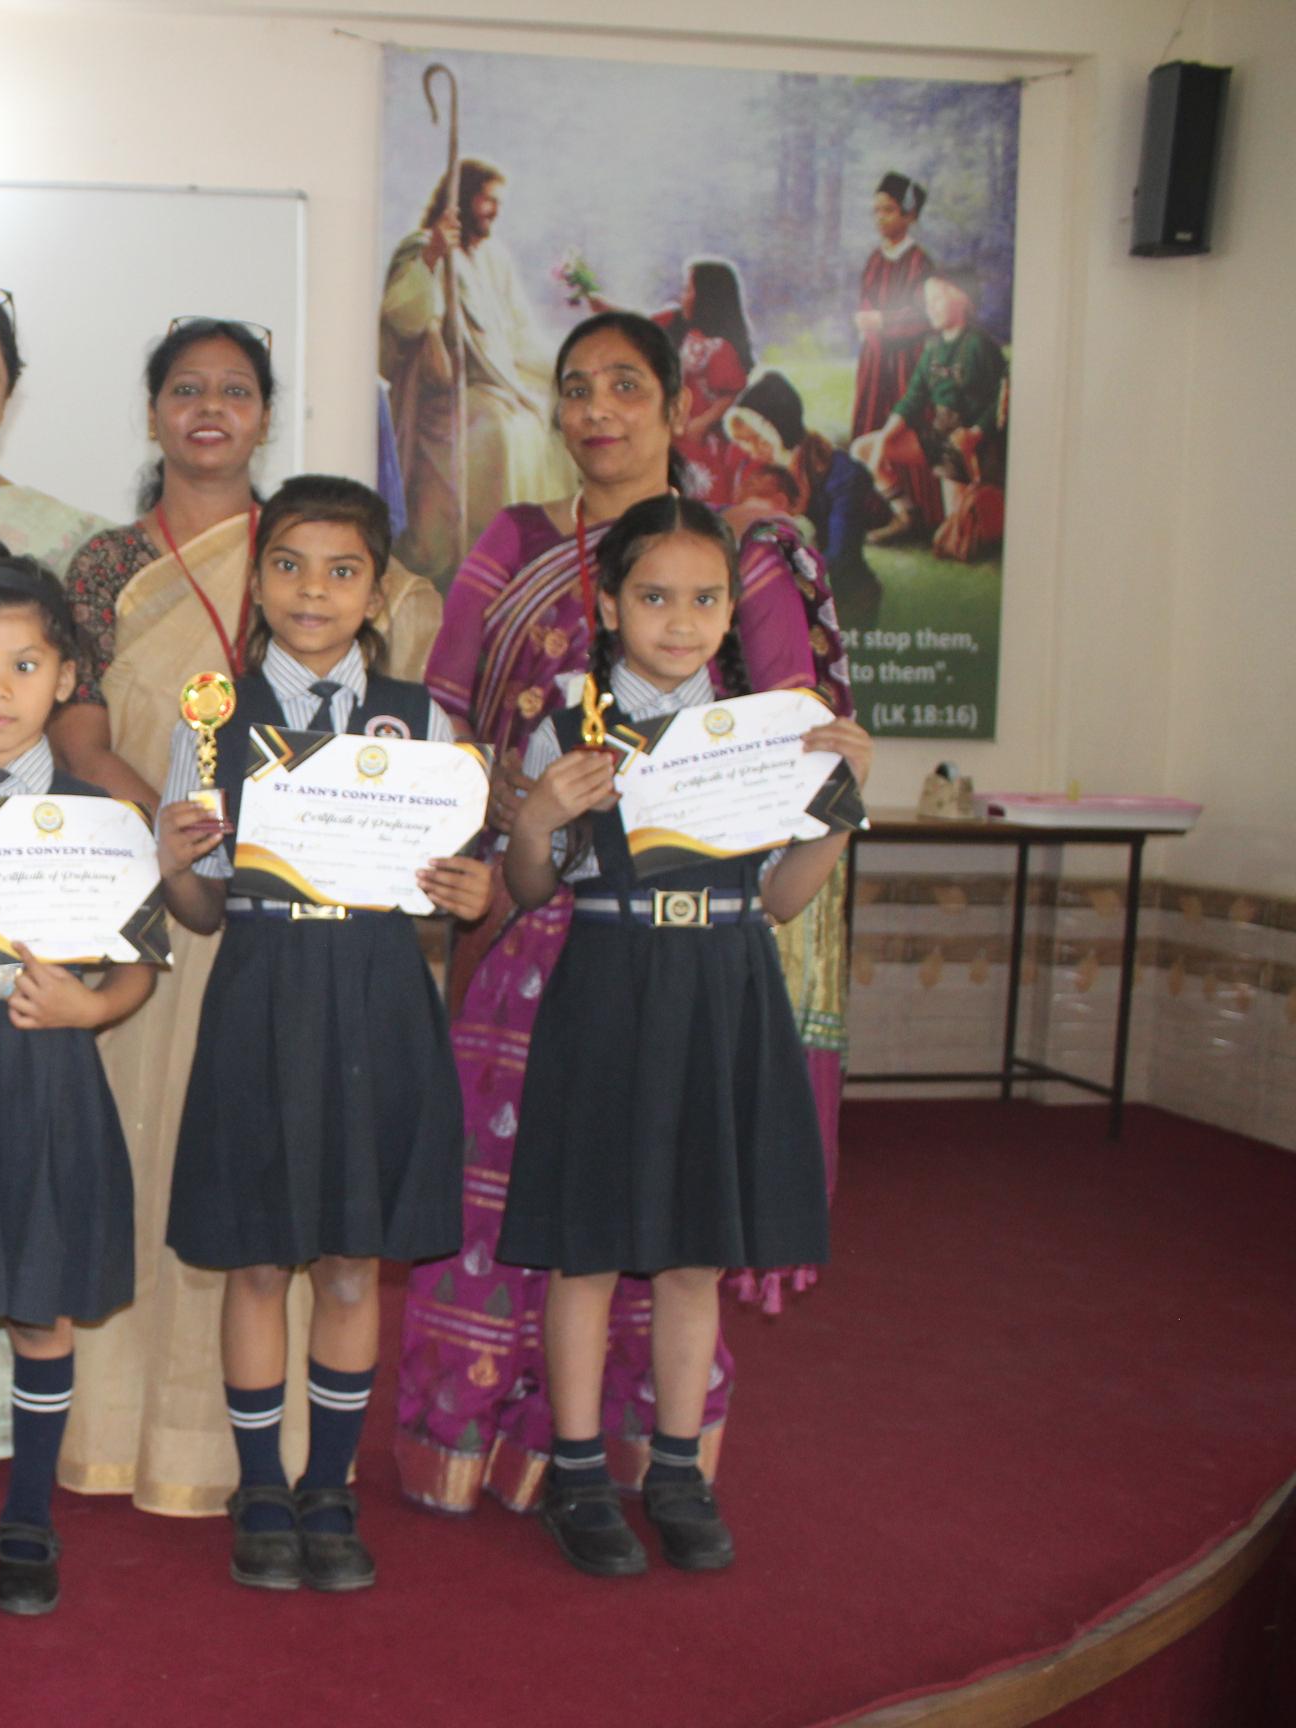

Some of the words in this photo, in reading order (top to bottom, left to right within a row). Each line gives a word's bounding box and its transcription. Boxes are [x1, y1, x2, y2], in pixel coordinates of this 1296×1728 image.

[839, 628, 859, 648] ot
[864, 628, 912, 652] stop
[915, 627, 979, 652] them,
[851, 662, 875, 682] to
[872, 703, 907, 729] (LK
[912, 703, 978, 730] 18:16)
[640, 766, 659, 776] ST.
[662, 755, 700, 770] ANN'S
[702, 740, 762, 760] CONVENT
[765, 733, 802, 747] SCHO
[674, 769, 723, 792] Certificate
[739, 758, 797, 778] Proficiency
[274, 782, 294, 793] ST.
[297, 784, 338, 798] ANN'S
[341, 788, 405, 804] CONVENT
[408, 795, 459, 808] SCHOOL
[300, 811, 355, 827] Certificate
[371, 818, 432, 833] Proficiency
[26, 845, 86, 857] CONVENT
[89, 846, 135, 858] SCHOOL
[62, 869, 117, 885] Proficiency
